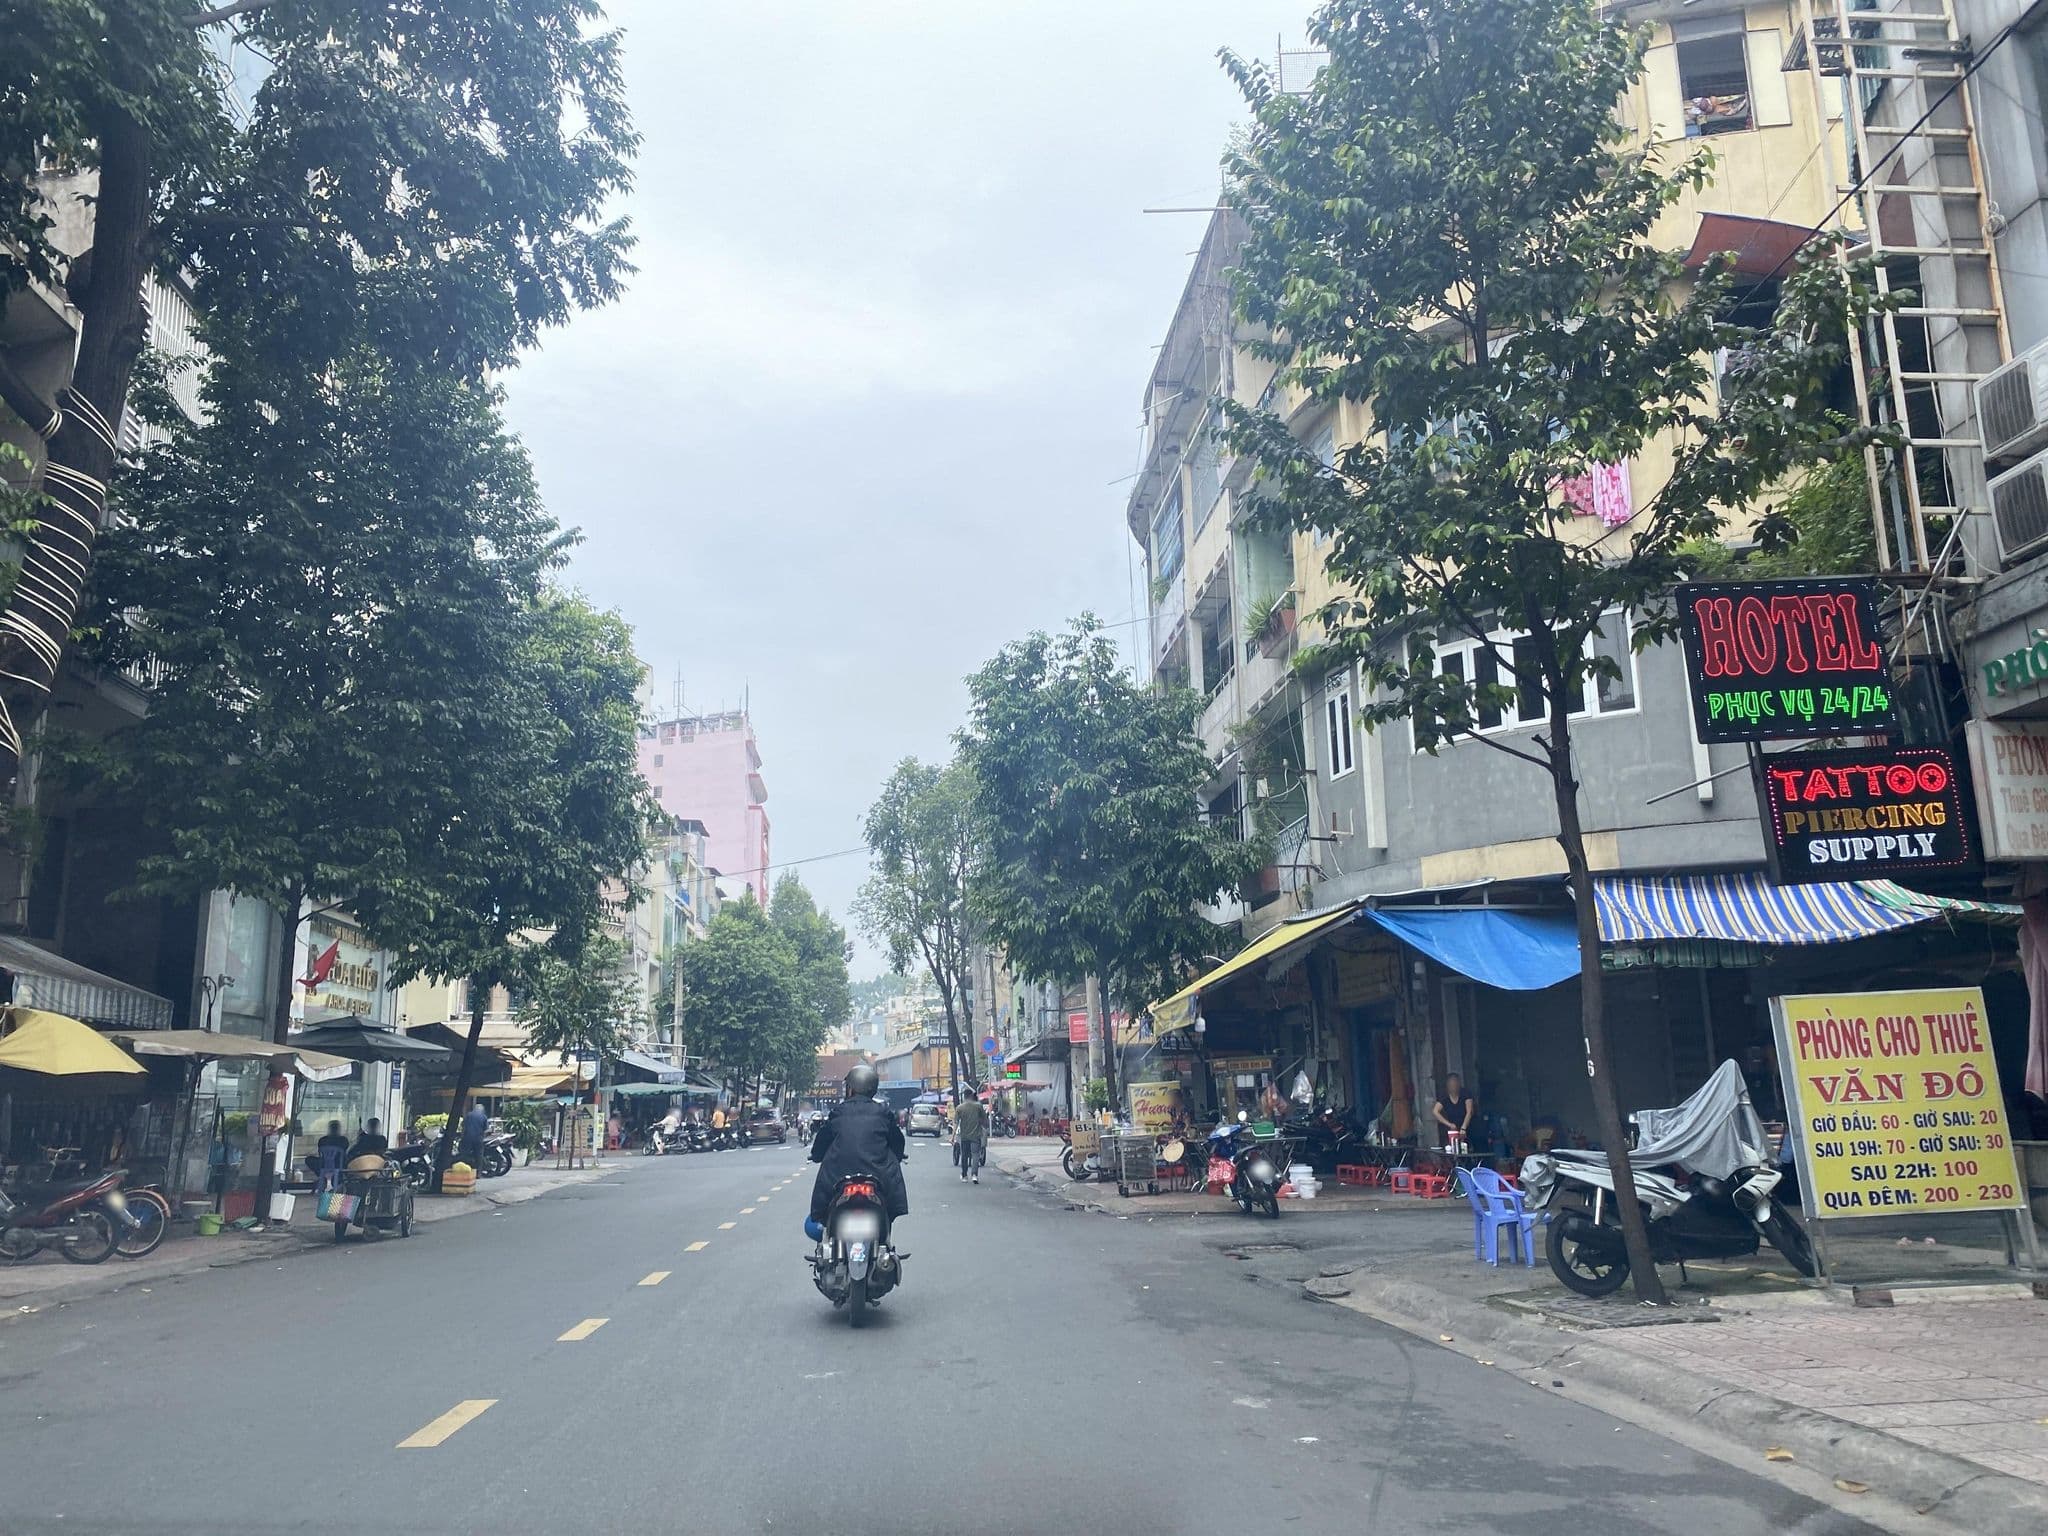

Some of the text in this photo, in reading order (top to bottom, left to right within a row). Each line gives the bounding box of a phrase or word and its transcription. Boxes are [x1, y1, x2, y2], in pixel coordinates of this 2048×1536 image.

[1695, 593, 1879, 677] HOTEL
[1708, 686, 1889, 724] PHỤC VỤ 24/24
[1773, 762, 1947, 802] TATTOO
[1783, 802, 1946, 834] PIERCING
[1808, 832, 1937, 864] SUPPLY
[1796, 1002, 1984, 1060] PHÒNG CHO THUÊ
[1809, 1062, 1986, 1104] VĂN ĐÔ
[1812, 1113, 1836, 1132] GIỜ
[1841, 1110, 1877, 1131] ĐẦU:
[1881, 1115, 1899, 1130] 60
[1913, 1109, 1938, 1128] GIỜ
[1942, 1111, 1975, 1127] SAU:
[1979, 1110, 1998, 1125] 20
[1815, 1142, 1843, 1157] SAU
[1849, 1140, 1882, 1156] 19H:
[1886, 1139, 1905, 1154] 70
[1919, 1133, 1943, 1153] GIỜ
[1948, 1136, 1981, 1151] SAU:
[1984, 1134, 2003, 1149] 30
[1851, 1160, 1978, 1181] SAU 22H: 100
[1824, 1191, 1862, 1210] QUA
[1869, 1186, 1918, 1205] ĐÊM:
[1924, 1186, 1959, 1203] 200
[1978, 1184, 2013, 1200] 230
